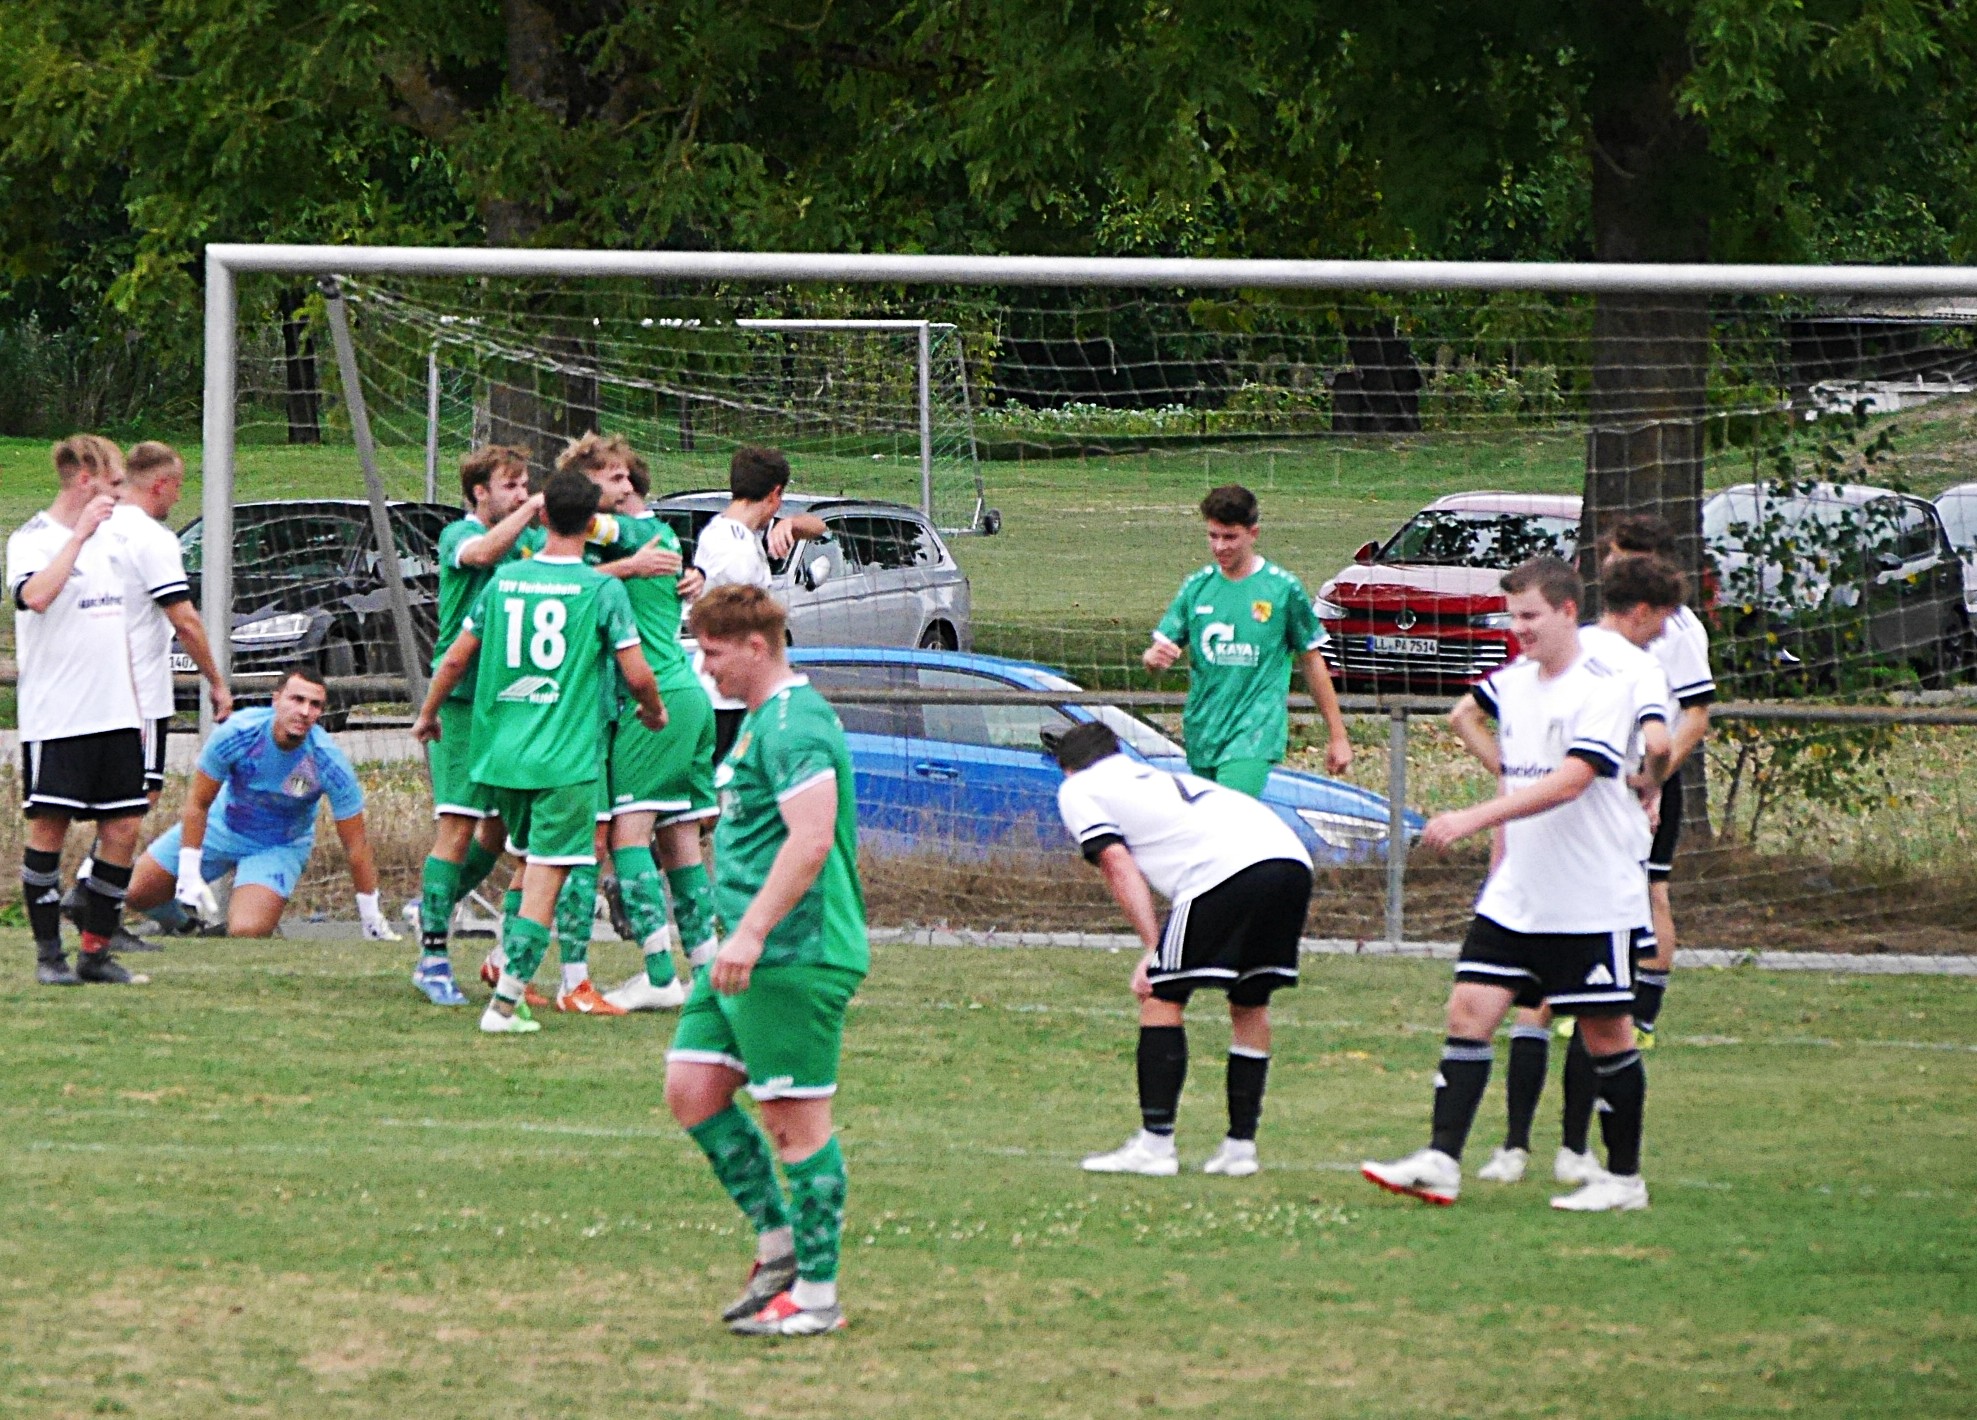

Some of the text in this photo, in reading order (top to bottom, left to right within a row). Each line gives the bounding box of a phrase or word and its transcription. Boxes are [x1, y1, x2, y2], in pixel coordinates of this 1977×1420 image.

[504, 597, 567, 670] 18
[1216, 643, 1253, 656] KAYA
[1410, 640, 1436, 653] 7514
